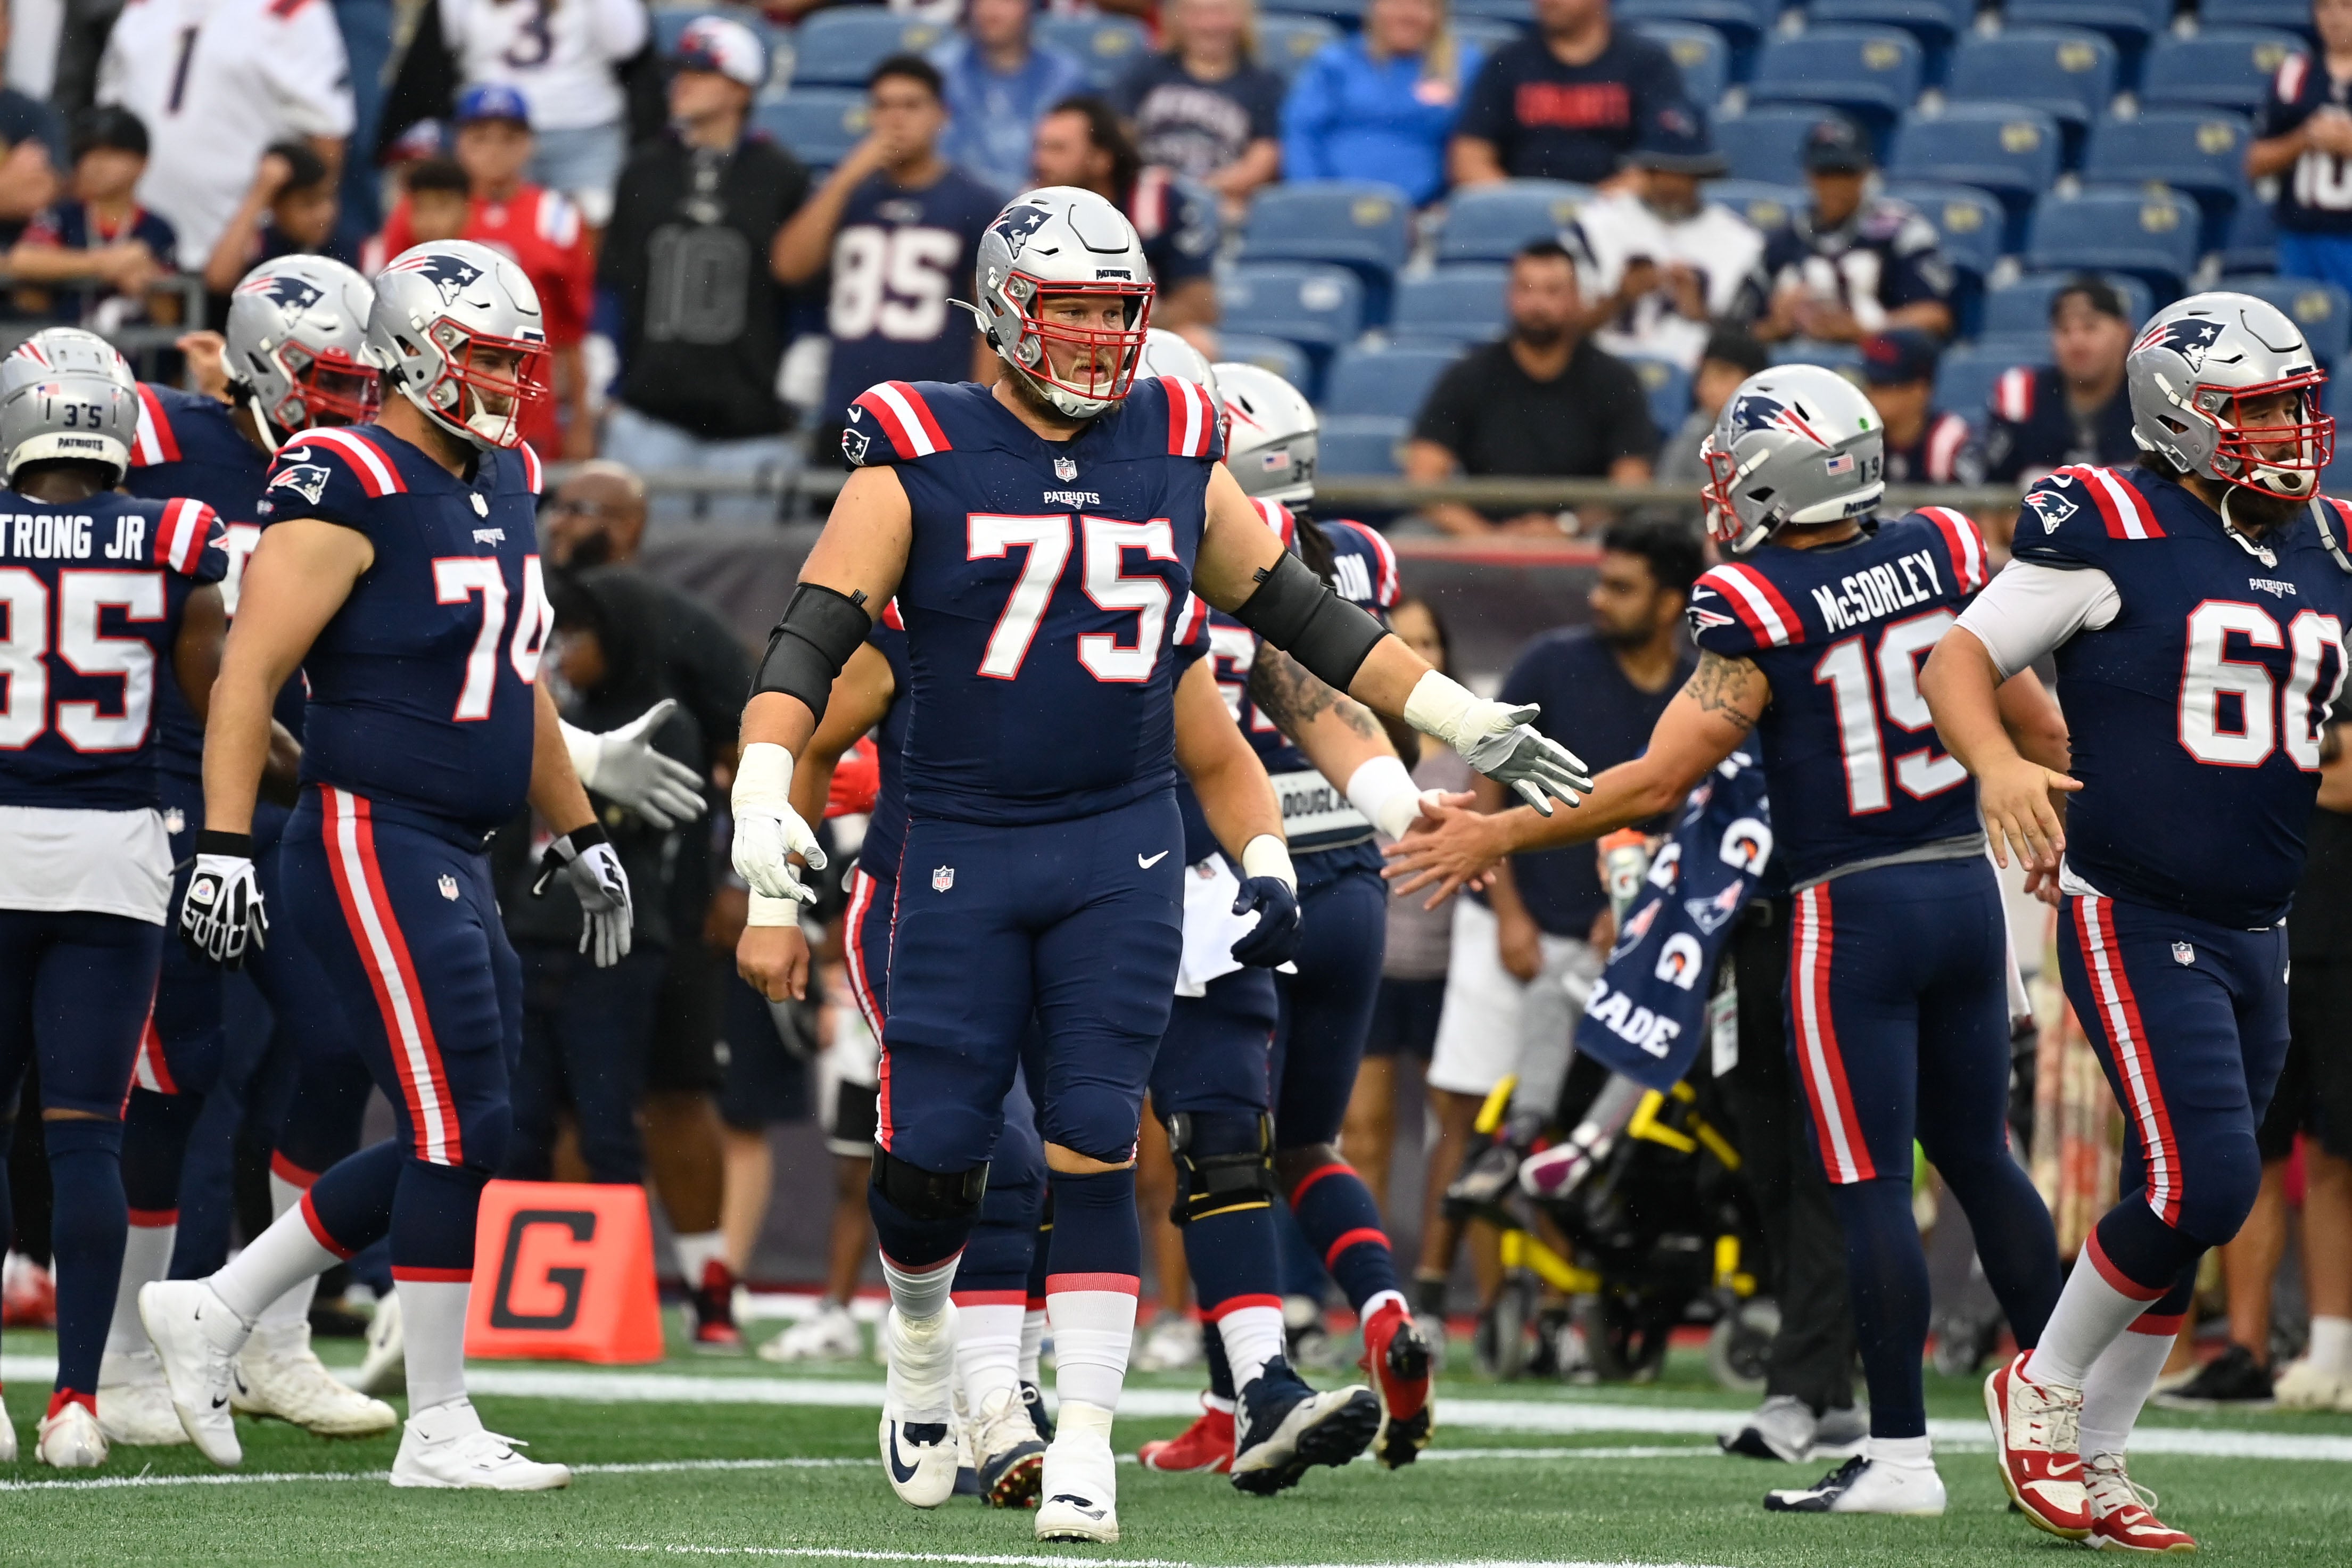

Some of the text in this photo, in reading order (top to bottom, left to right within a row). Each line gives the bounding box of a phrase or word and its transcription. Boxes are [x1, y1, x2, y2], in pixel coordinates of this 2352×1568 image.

[645, 223, 750, 343] 10
[827, 224, 962, 341] 85
[1096, 269, 1131, 280] PATRIOTS
[58, 438, 103, 451] PATRIOTS
[63, 403, 102, 428] 35
[1043, 491, 1100, 505] PATRIOTS
[1860, 456, 1879, 484] 19
[104, 515, 146, 561] JR
[967, 513, 1178, 683] 75
[1811, 549, 1943, 634] McSORLEY
[2248, 577, 2297, 596] PATRIOTS
[432, 554, 555, 722] 74
[1813, 606, 1968, 818] 19
[2177, 598, 2348, 772] 60
[490, 1209, 597, 1331] G
